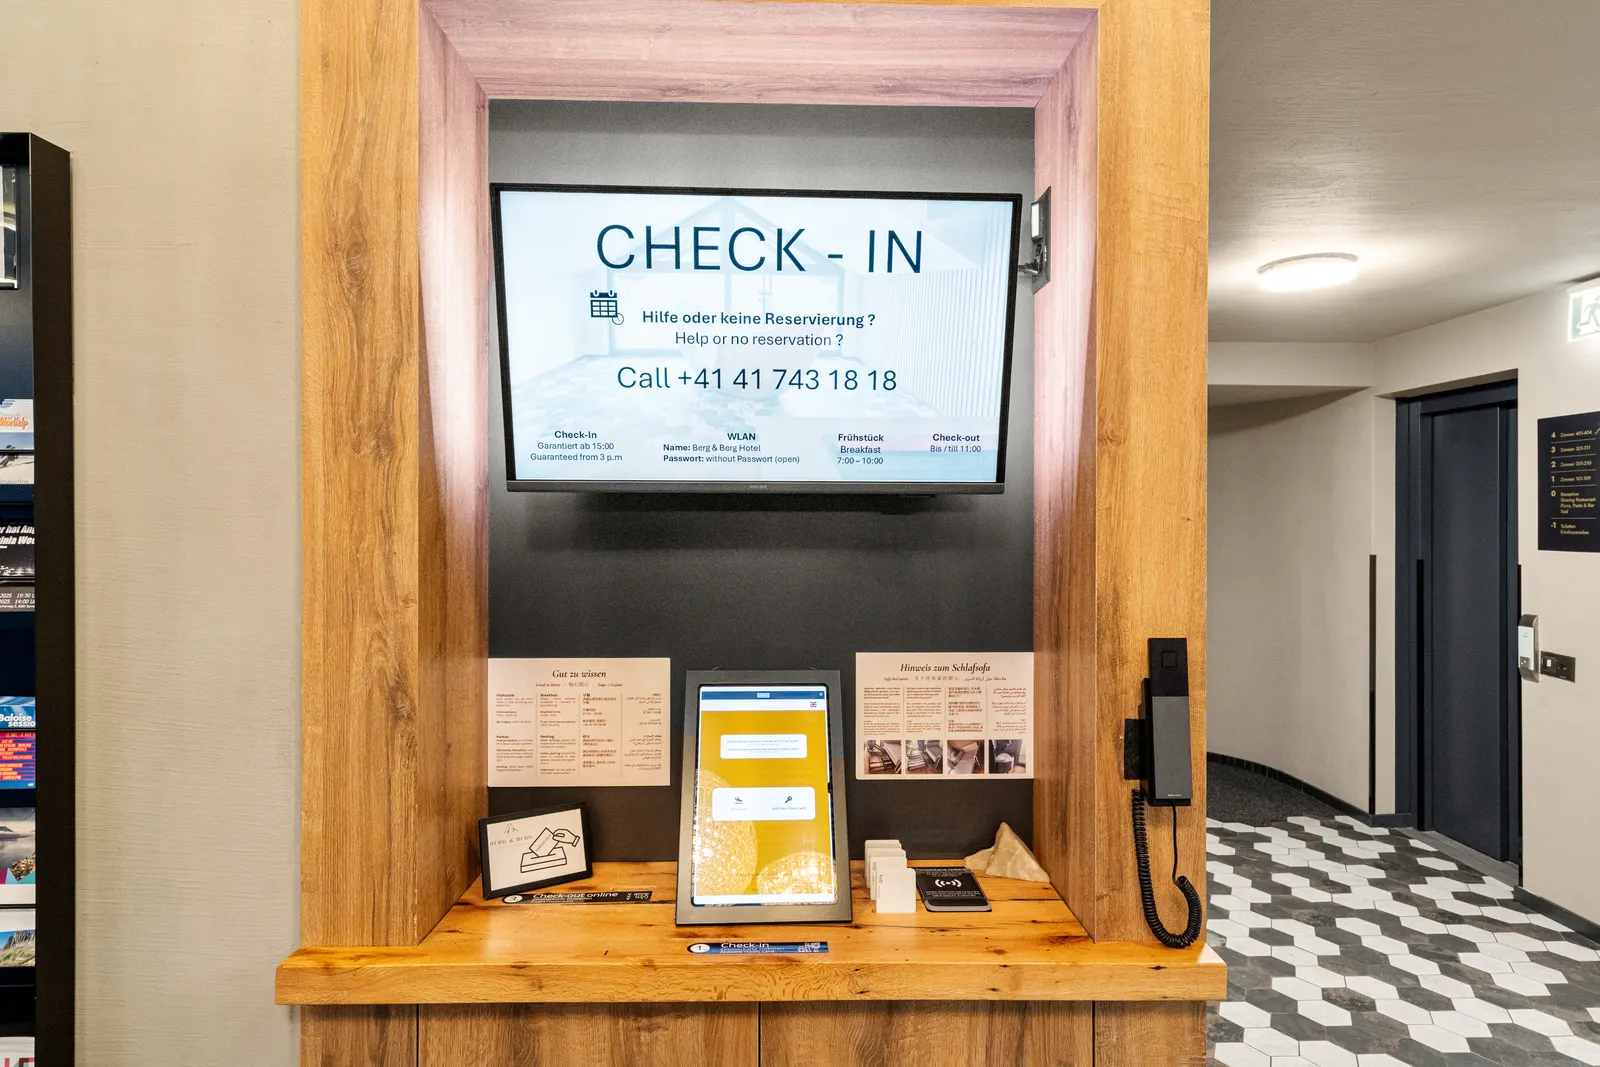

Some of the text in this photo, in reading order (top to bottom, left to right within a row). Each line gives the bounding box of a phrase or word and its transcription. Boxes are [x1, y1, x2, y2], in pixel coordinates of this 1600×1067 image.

[596, 224, 807, 272] CHECK
[868, 229, 923, 274] IN
[642, 310, 877, 329] Hilfe oder keine Reservierung ?
[675, 331, 844, 348] Help or no reservation ?
[617, 366, 898, 391] Call +41 41 743 18 18
[554, 430, 598, 439] Check-In
[726, 432, 757, 441] WLAN
[838, 433, 884, 442] Frühstück
[932, 433, 981, 442] Check-out
[537, 441, 615, 450] Garantiert ab 15:00
[663, 443, 762, 453] Name: Berg & Berg Hotel
[840, 445, 881, 454] Breakfast
[930, 444, 942, 453] Bis
[948, 445, 959, 453] till
[960, 445, 982, 453] 11:00
[530, 453, 623, 462] Guaranteed from 3 p.m
[663, 455, 800, 464] Passwort: without Passwort (open)
[837, 457, 855, 465] 7:00
[862, 457, 884, 465] 10:00
[6, 525, 20, 534] hat
[1550, 521, 1557, 529] -1
[900, 663, 932, 672] Hinweis
[952, 662, 991, 674] Schlafsofa
[552, 669, 568, 678] Gut
[581, 669, 607, 678] wissen
[0, 712, 33, 722] Baloise
